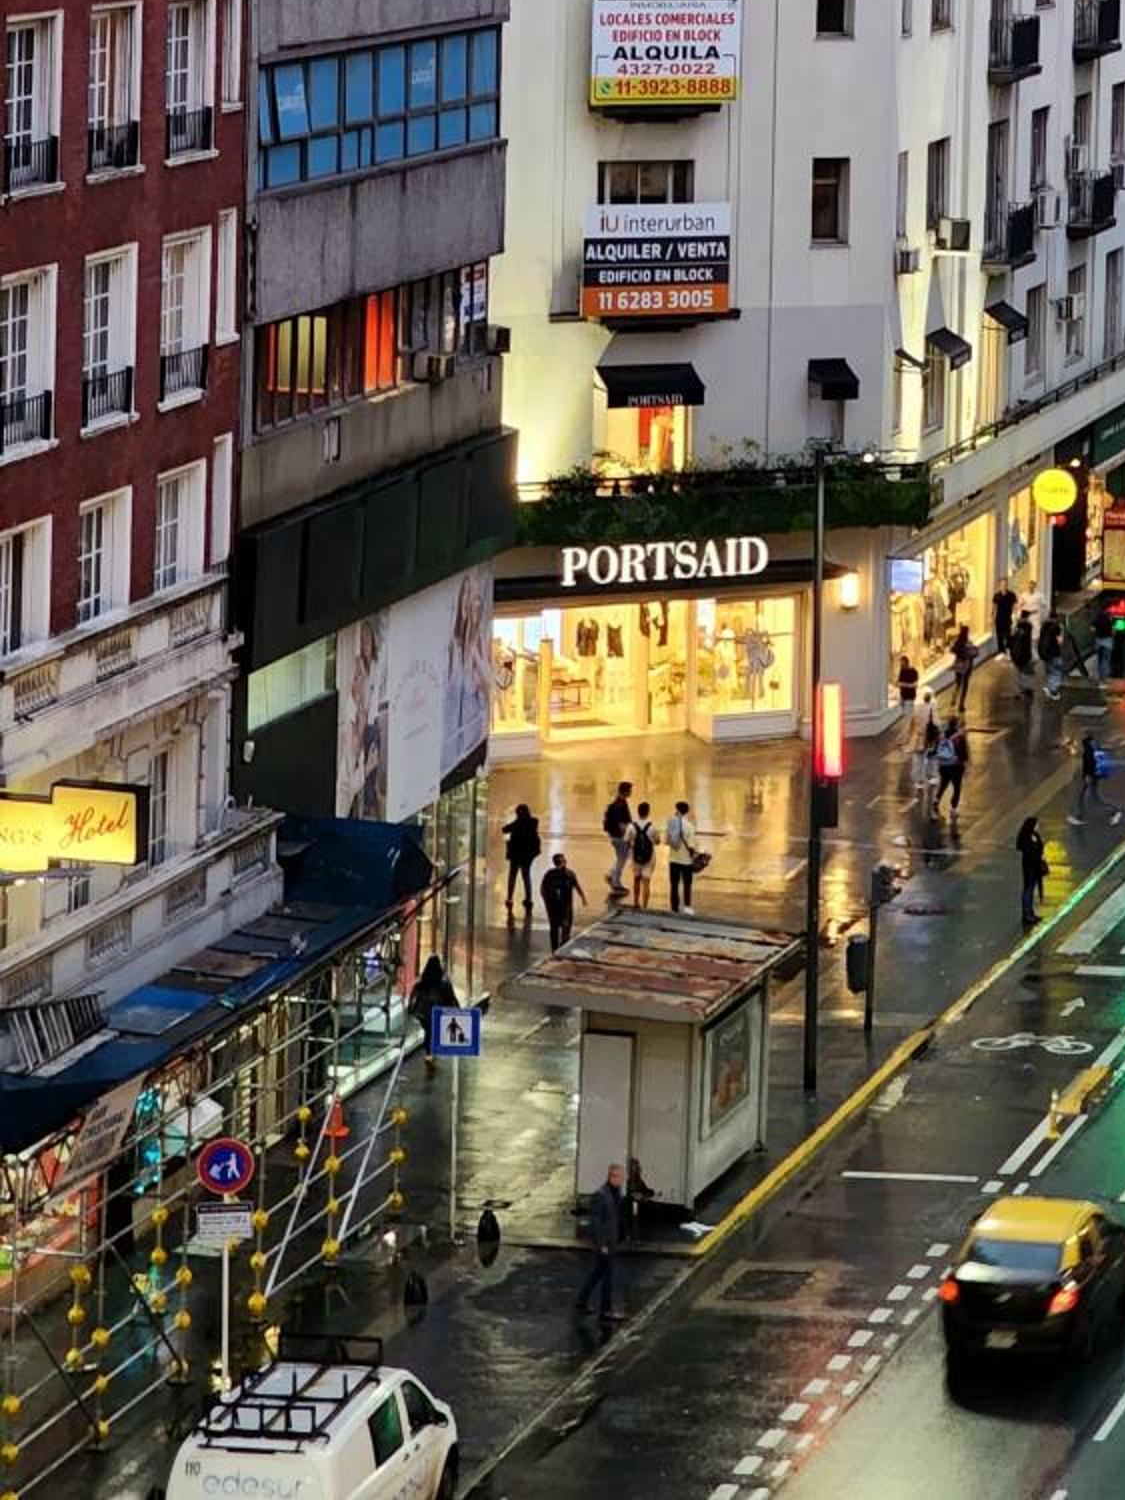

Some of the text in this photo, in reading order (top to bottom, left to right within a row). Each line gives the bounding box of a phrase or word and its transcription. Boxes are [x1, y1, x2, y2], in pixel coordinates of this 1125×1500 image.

[600, 12, 735, 26] LOCALES COMERCIALES
[612, 30, 721, 43] EDIFICIO EN BLOCK
[612, 46, 720, 61] ALQUILA
[617, 63, 716, 76] 4327-0022
[615, 79, 731, 95] 11-3923-8888
[624, 212, 715, 233] interurban
[585, 243, 662, 262] ALQUILER
[677, 241, 727, 258] VENTA
[598, 267, 714, 284] EDIFICIO EN BLOCK
[598, 289, 713, 310] 11 6283 3005
[560, 536, 769, 587] PORTSAID
[60, 800, 129, 850] Hotel
[203, 1469, 304, 1499] edesur
